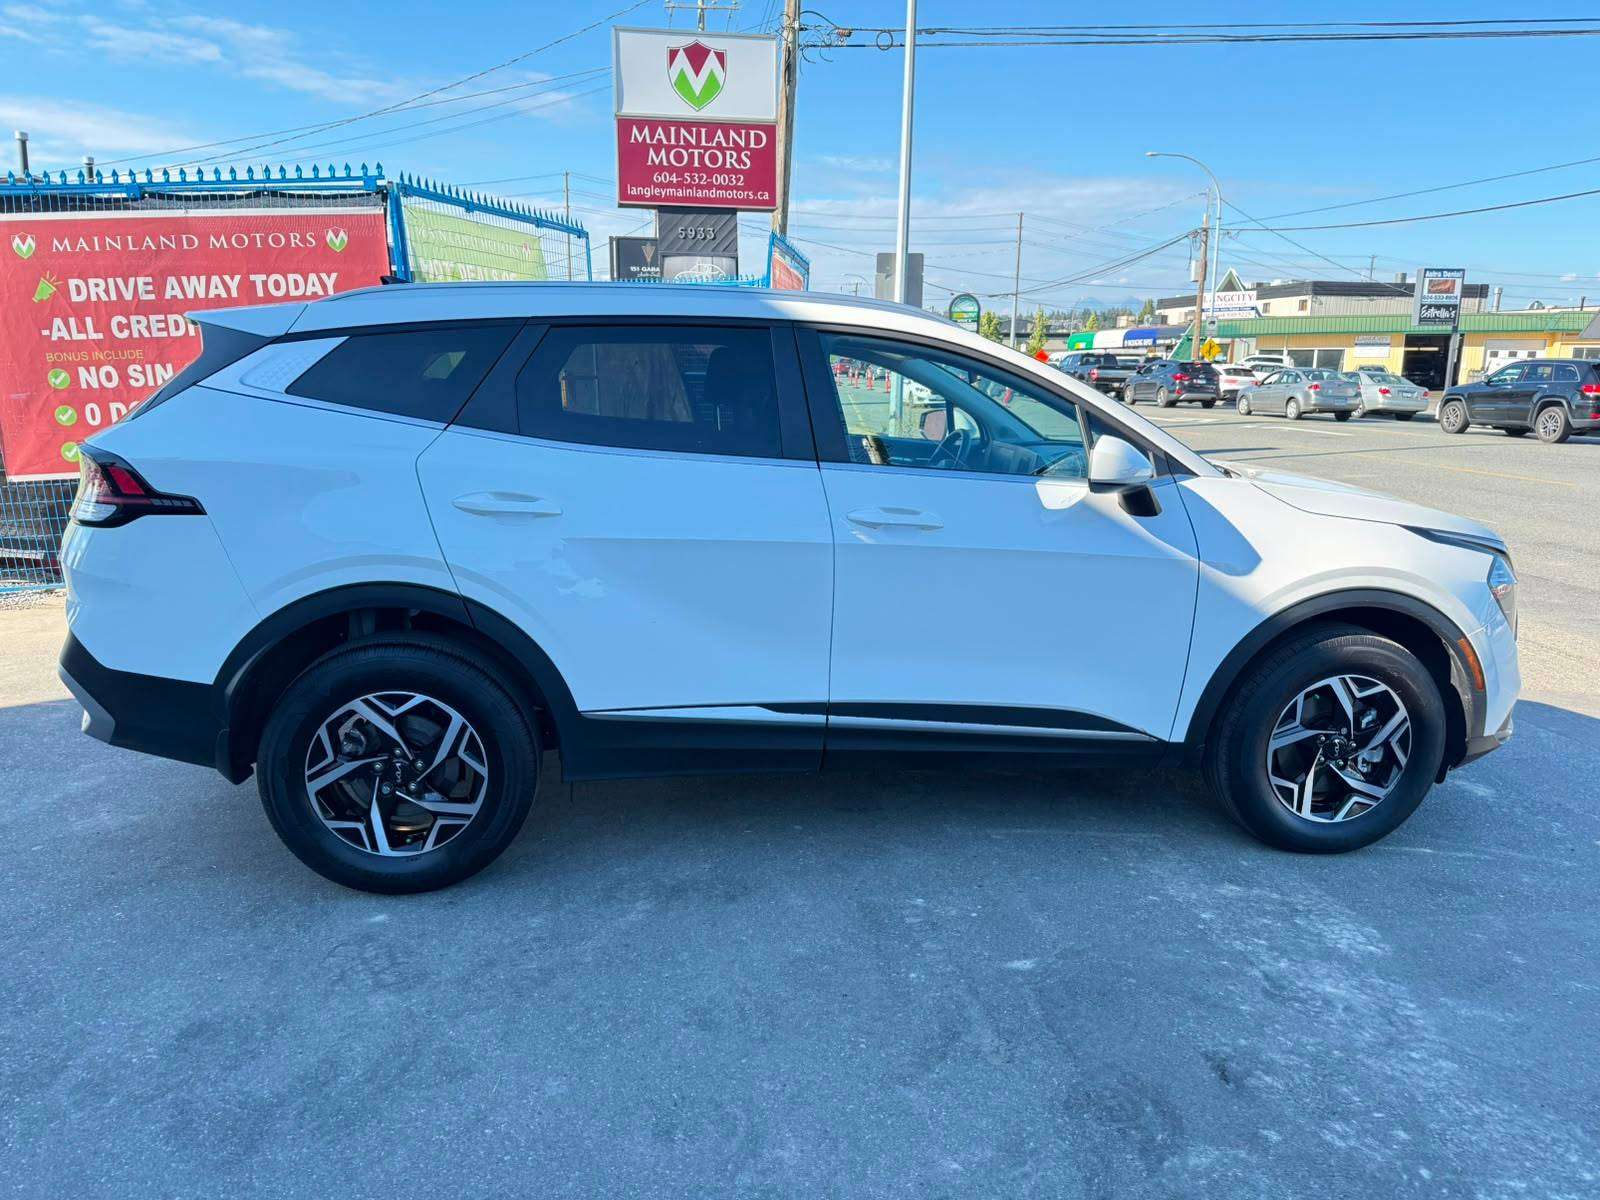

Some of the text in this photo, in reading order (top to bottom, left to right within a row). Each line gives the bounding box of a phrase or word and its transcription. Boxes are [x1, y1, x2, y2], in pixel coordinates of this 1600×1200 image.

[629, 125, 767, 149] MAINLAND
[646, 148, 751, 169] MOTORS
[653, 172, 744, 186] 604-532-0032
[627, 184, 769, 201] langleymainlandmotors.ca
[52, 231, 317, 252] MAINLAND MOTORS
[677, 225, 717, 240] 5933
[69, 272, 338, 302] DRIVE AWAY TODAY
[1420, 304, 1457, 319] Estrella's
[46, 349, 144, 363] BONUS INCLUDE
[79, 364, 119, 390] NO
